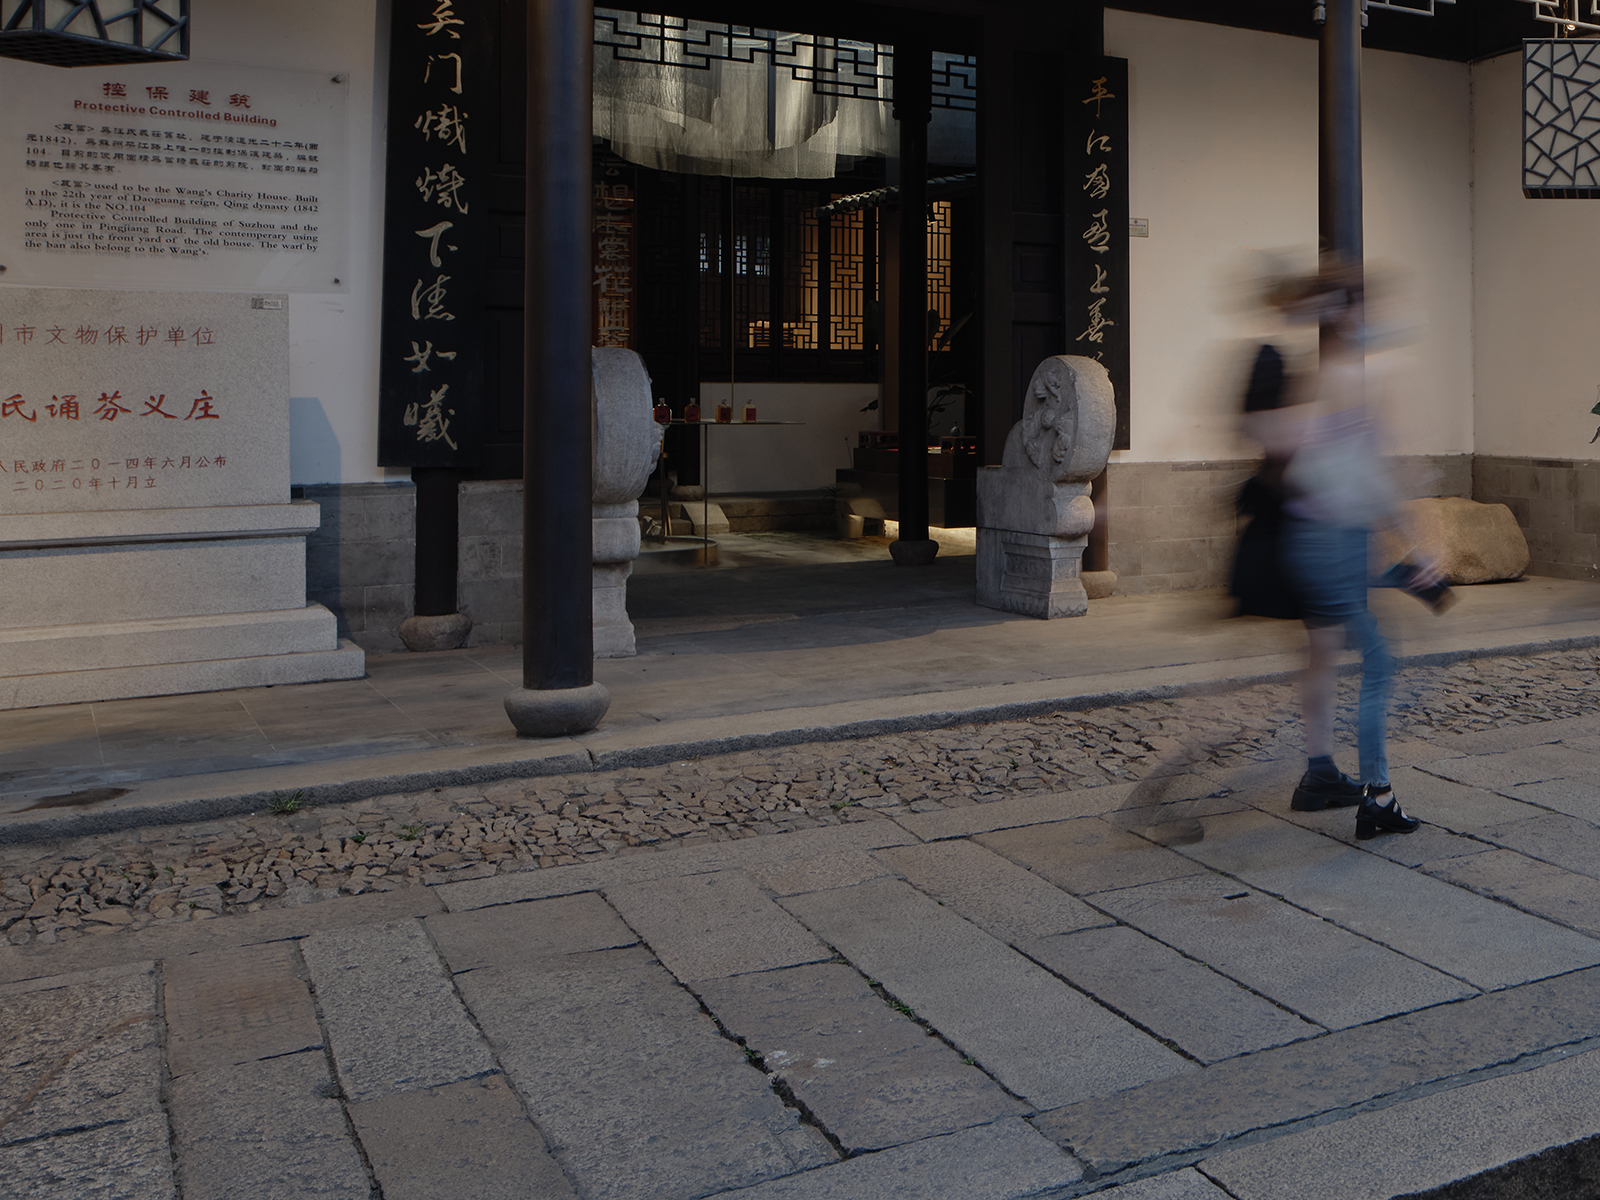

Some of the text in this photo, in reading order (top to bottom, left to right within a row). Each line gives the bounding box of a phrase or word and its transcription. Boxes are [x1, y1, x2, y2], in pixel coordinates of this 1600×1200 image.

[103, 82, 252, 109] 控保建筑
[74, 100, 277, 127] Protective Controlled Building
[25, 188, 36, 196] in
[41, 189, 58, 197] the
[62, 190, 85, 198] 22th
[90, 193, 113, 201] year
[132, 194, 185, 205] Daoguang
[190, 199, 219, 207] reign,
[223, 200, 249, 209] Qing
[252, 202, 289, 212] dynasty
[293, 204, 319, 213] (1842
[95, 183, 118, 191] used
[175, 187, 212, 197] Wang's
[216, 189, 253, 200] Charity
[257, 192, 291, 201] House.
[295, 194, 318, 202] Built
[105, 203, 146, 212] NO.104
[25, 220, 49, 229] only
[100, 223, 149, 233] Pingjiang
[156, 226, 186, 234] Road.
[193, 228, 213, 236] The
[293, 234, 318, 243] using
[51, 210, 106, 220] Protective
[112, 213, 168, 223] Controlled
[174, 217, 217, 227] Building
[238, 220, 275, 229] Suzhou
[280, 223, 298, 231] and
[303, 224, 318, 232] the
[46, 241, 66, 249] ban
[70, 242, 90, 250] also
[95, 243, 130, 253] belong
[169, 247, 209, 256] Wang's.
[63, 232, 83, 240] just
[108, 233, 134, 241] front
[138, 236, 161, 244] yard
[223, 240, 254, 248] house.
[259, 241, 278, 249] The
[307, 243, 318, 252] by
[0, 323, 216, 347] 市文物保护单位
[1, 389, 220, 423] 氏诵芬义庄
